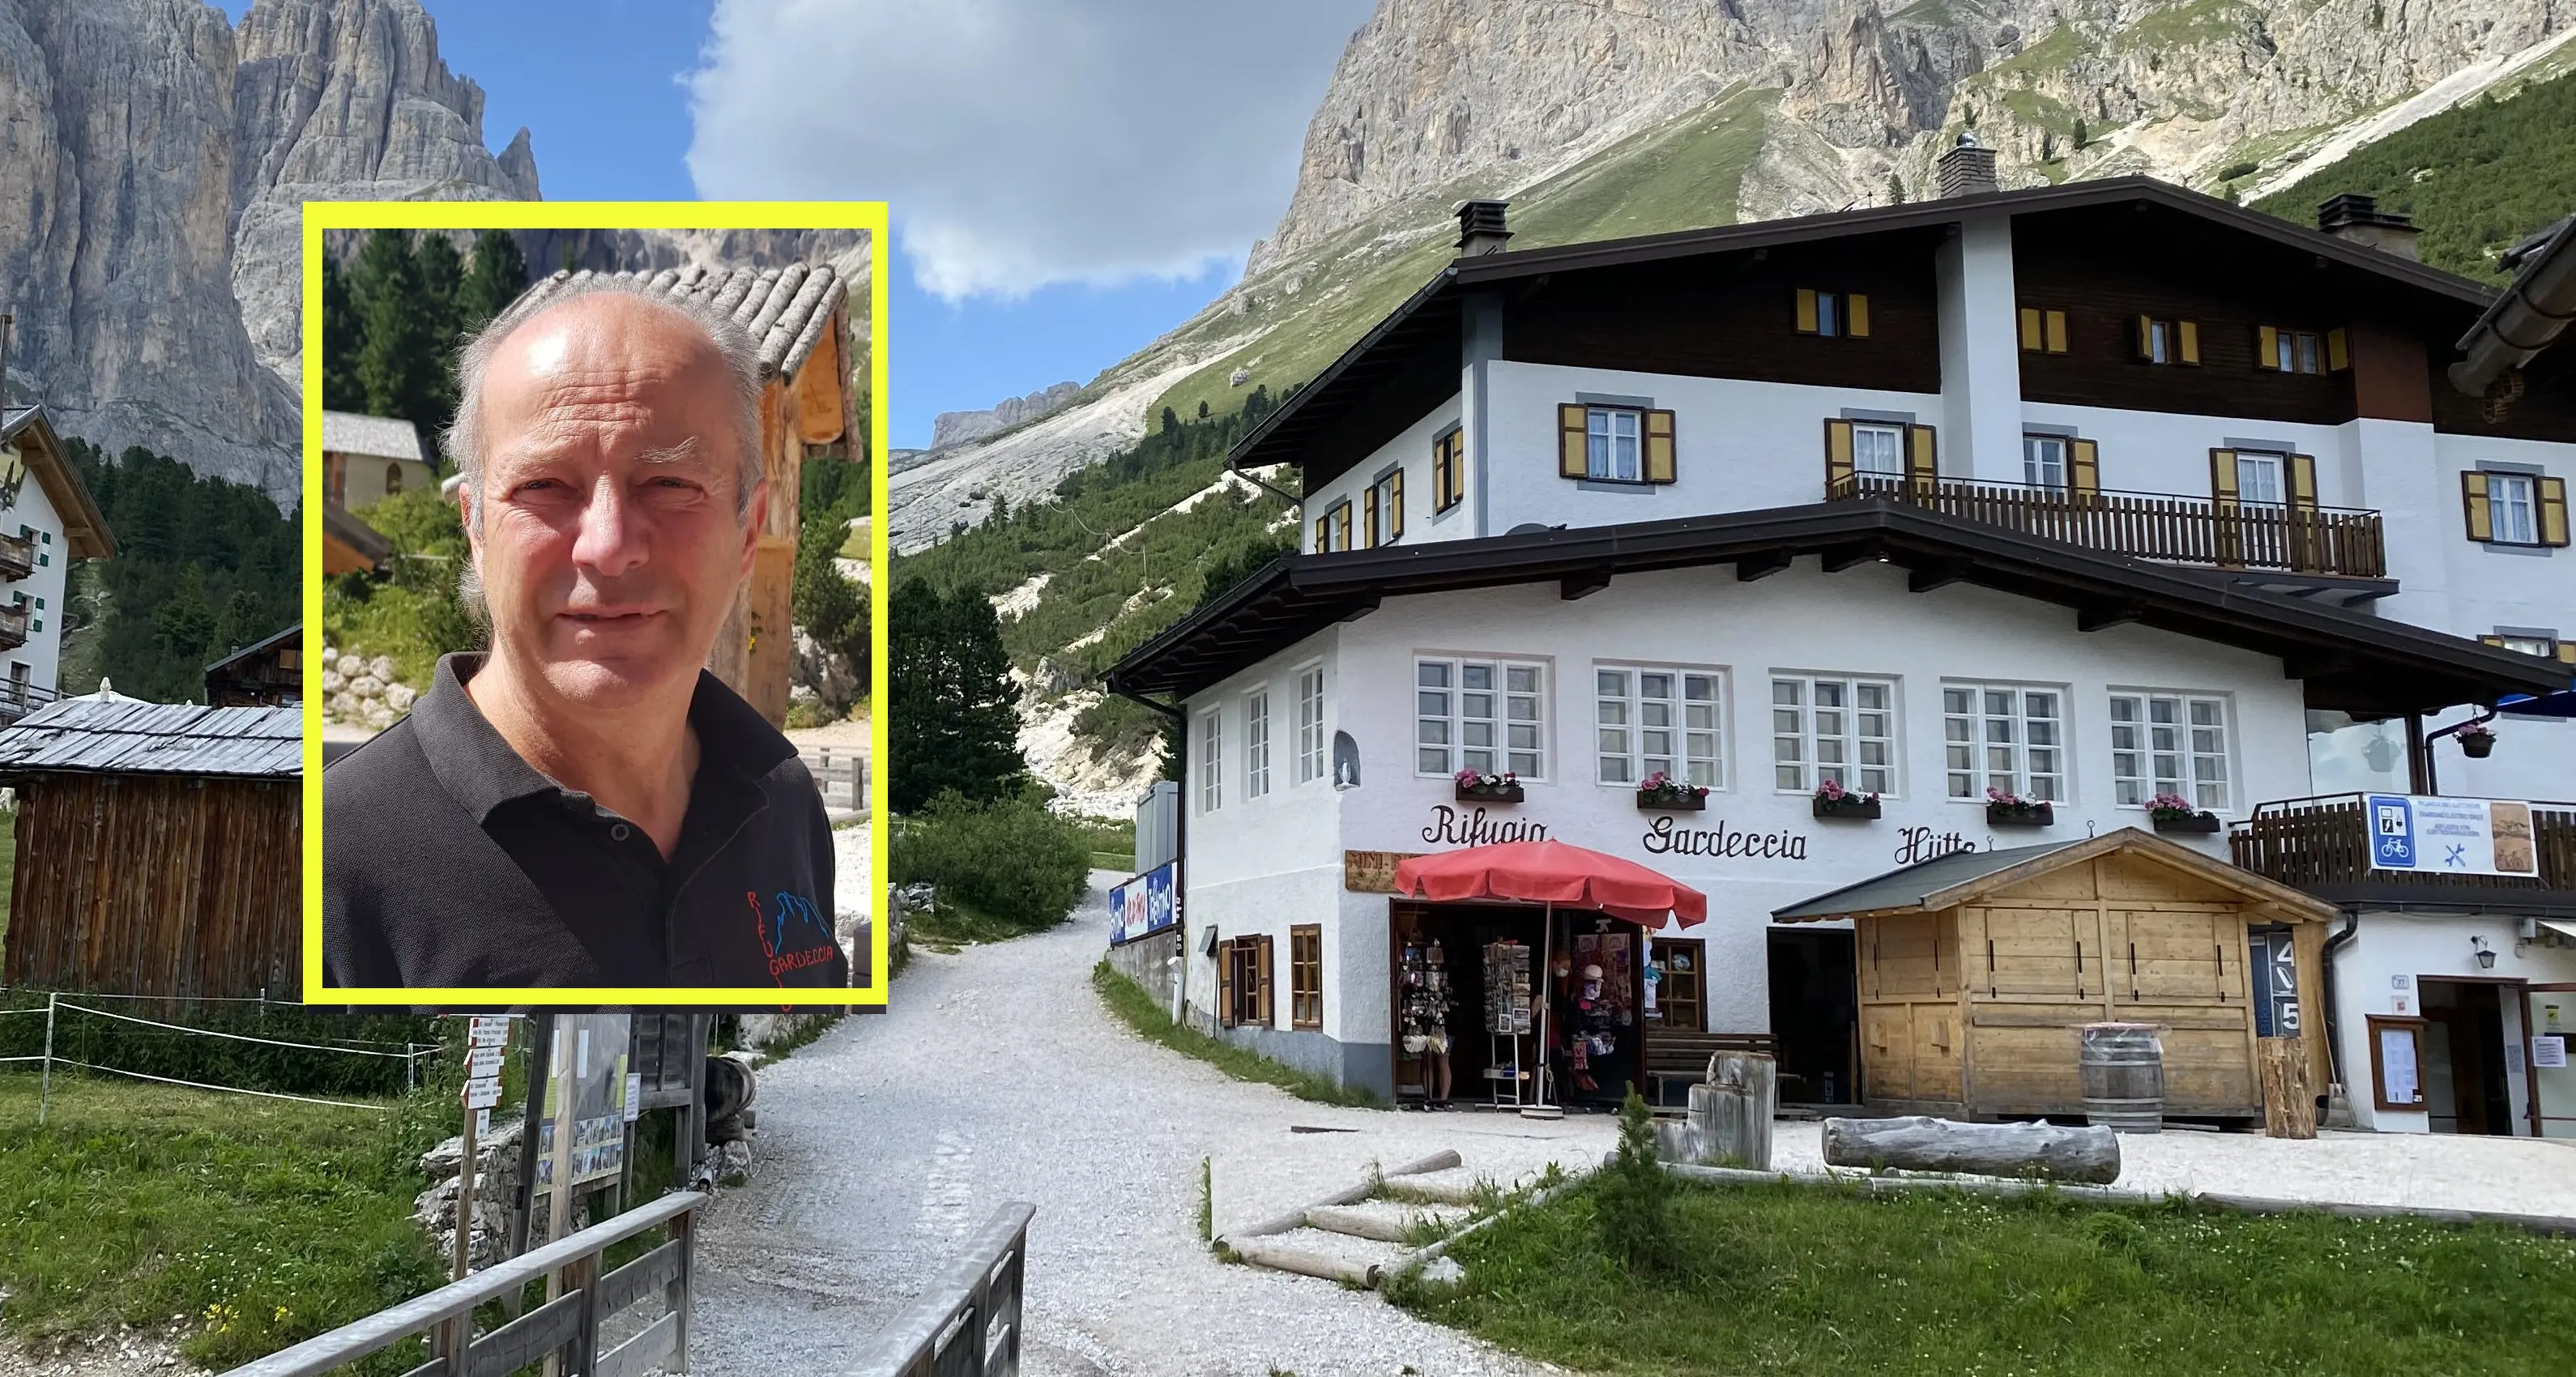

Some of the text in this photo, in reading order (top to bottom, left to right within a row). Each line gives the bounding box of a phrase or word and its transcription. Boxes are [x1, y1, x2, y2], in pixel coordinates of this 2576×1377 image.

[1422, 804, 1549, 848] Rifugio
[1643, 816, 1807, 860] Gardeccia
[770, 945, 834, 975] GARDECCIA
[2283, 1003, 2300, 1030] 5
